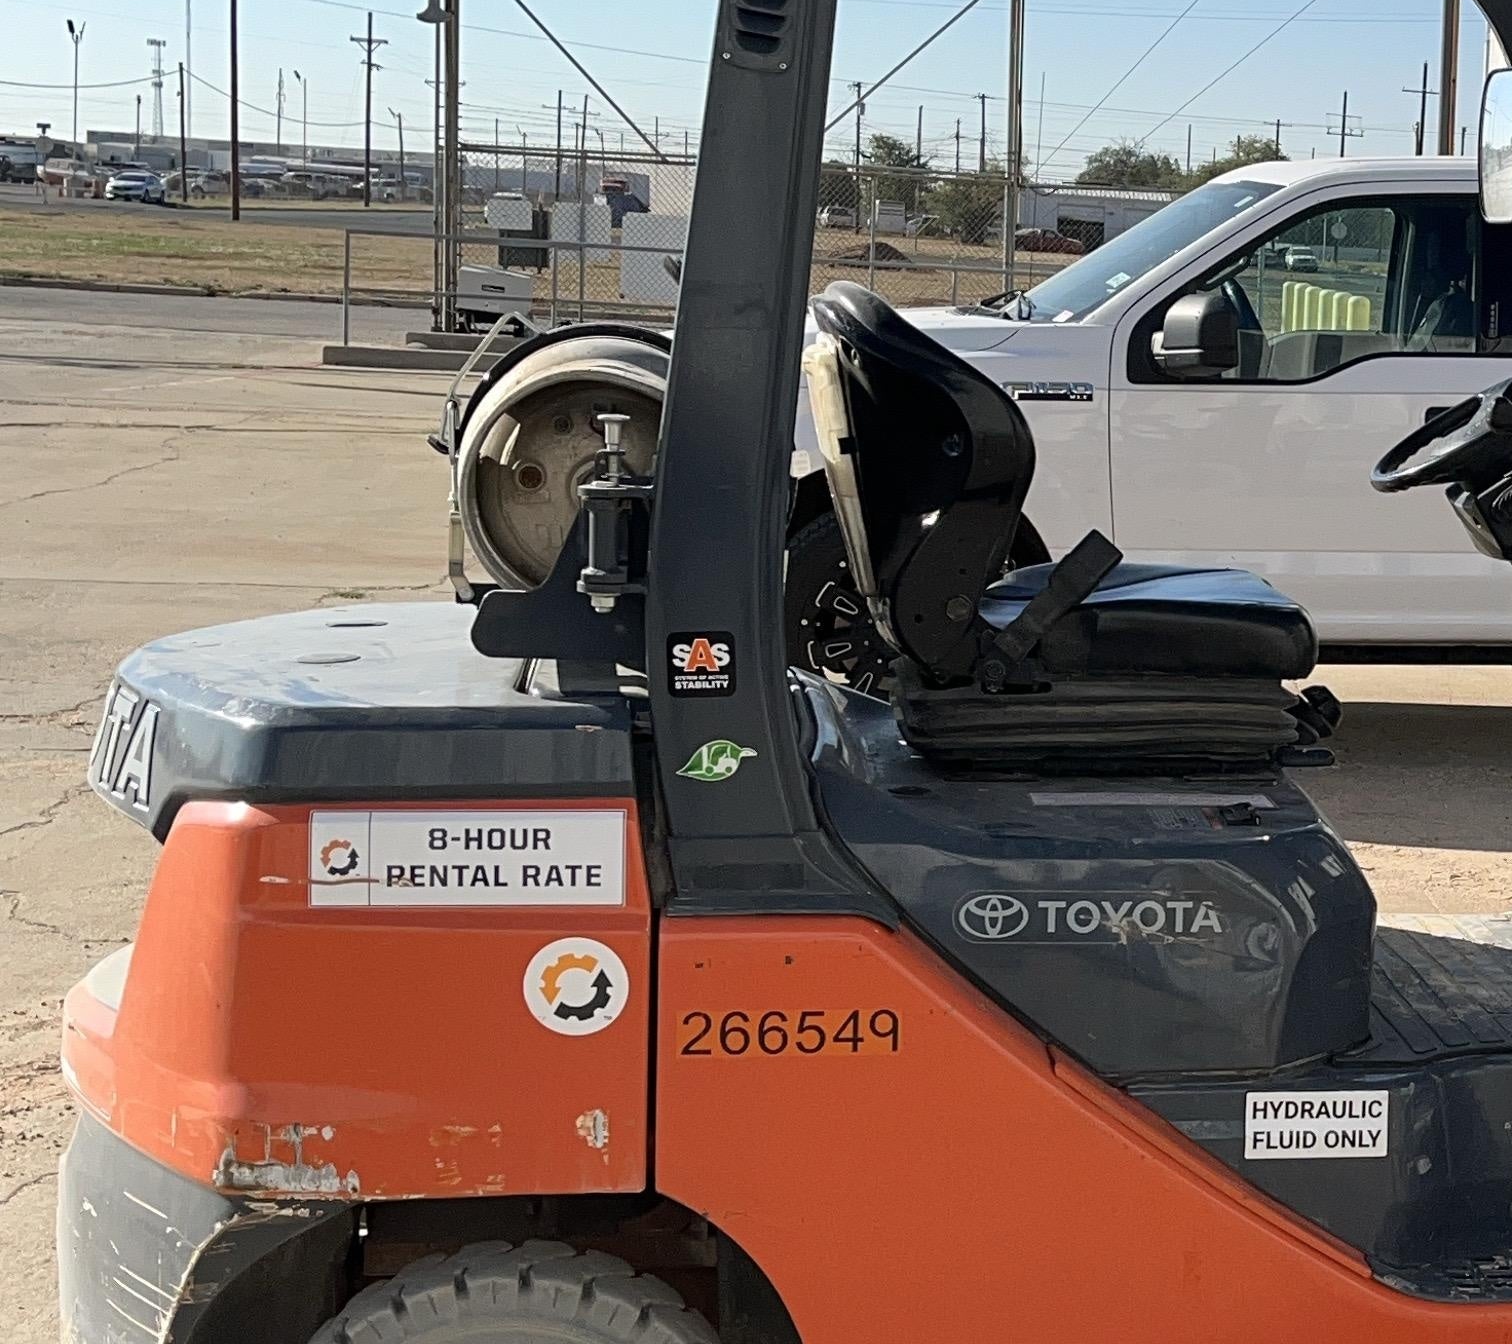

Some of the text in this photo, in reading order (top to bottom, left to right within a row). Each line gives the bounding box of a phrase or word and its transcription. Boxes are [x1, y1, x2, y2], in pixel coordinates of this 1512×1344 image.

[672, 638, 731, 672] SAS
[674, 680, 729, 690] STABILITY
[428, 828, 551, 851] 8-HOUR
[386, 864, 603, 888] RENTAL RATE
[1038, 899, 1223, 937] TOYOTA
[681, 1009, 900, 1056] 266549
[1252, 1099, 1383, 1120] HYDRAULIC
[1252, 1129, 1382, 1150] FLUID ONLY
